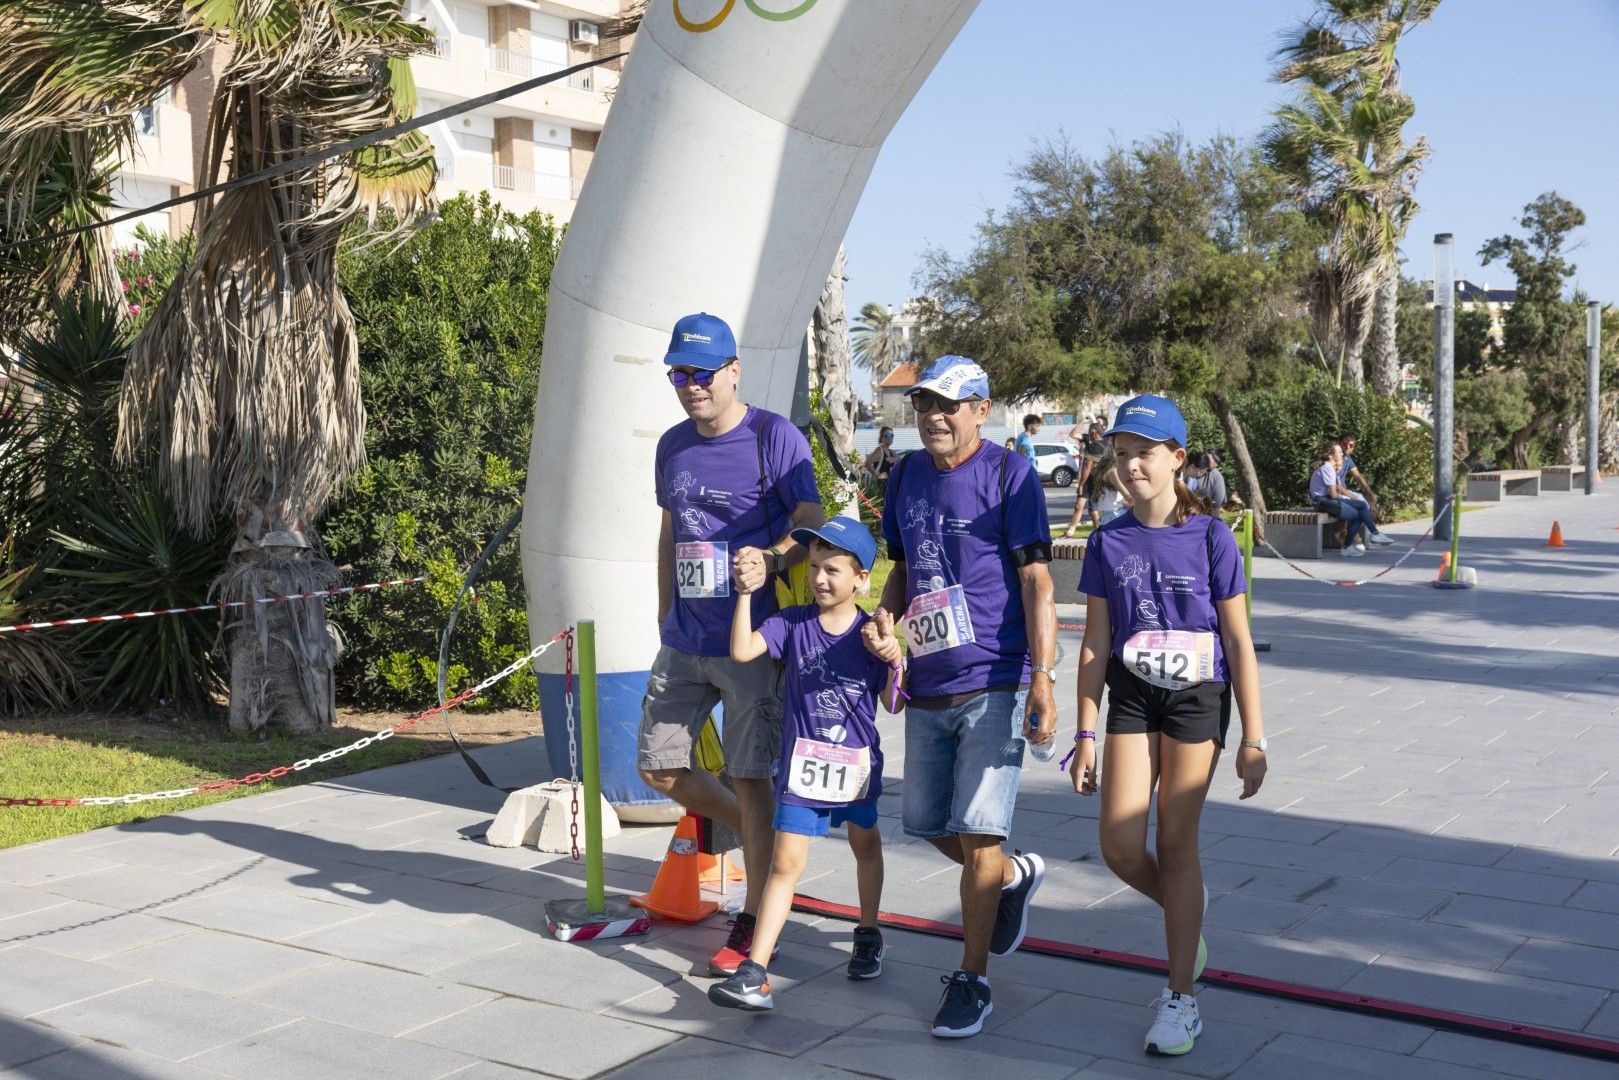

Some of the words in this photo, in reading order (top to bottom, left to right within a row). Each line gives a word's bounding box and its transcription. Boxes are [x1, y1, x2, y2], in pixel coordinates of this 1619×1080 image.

[678, 561, 704, 588] 321
[908, 611, 949, 646] 320
[1135, 651, 1188, 682] 512
[800, 760, 847, 791] 511
